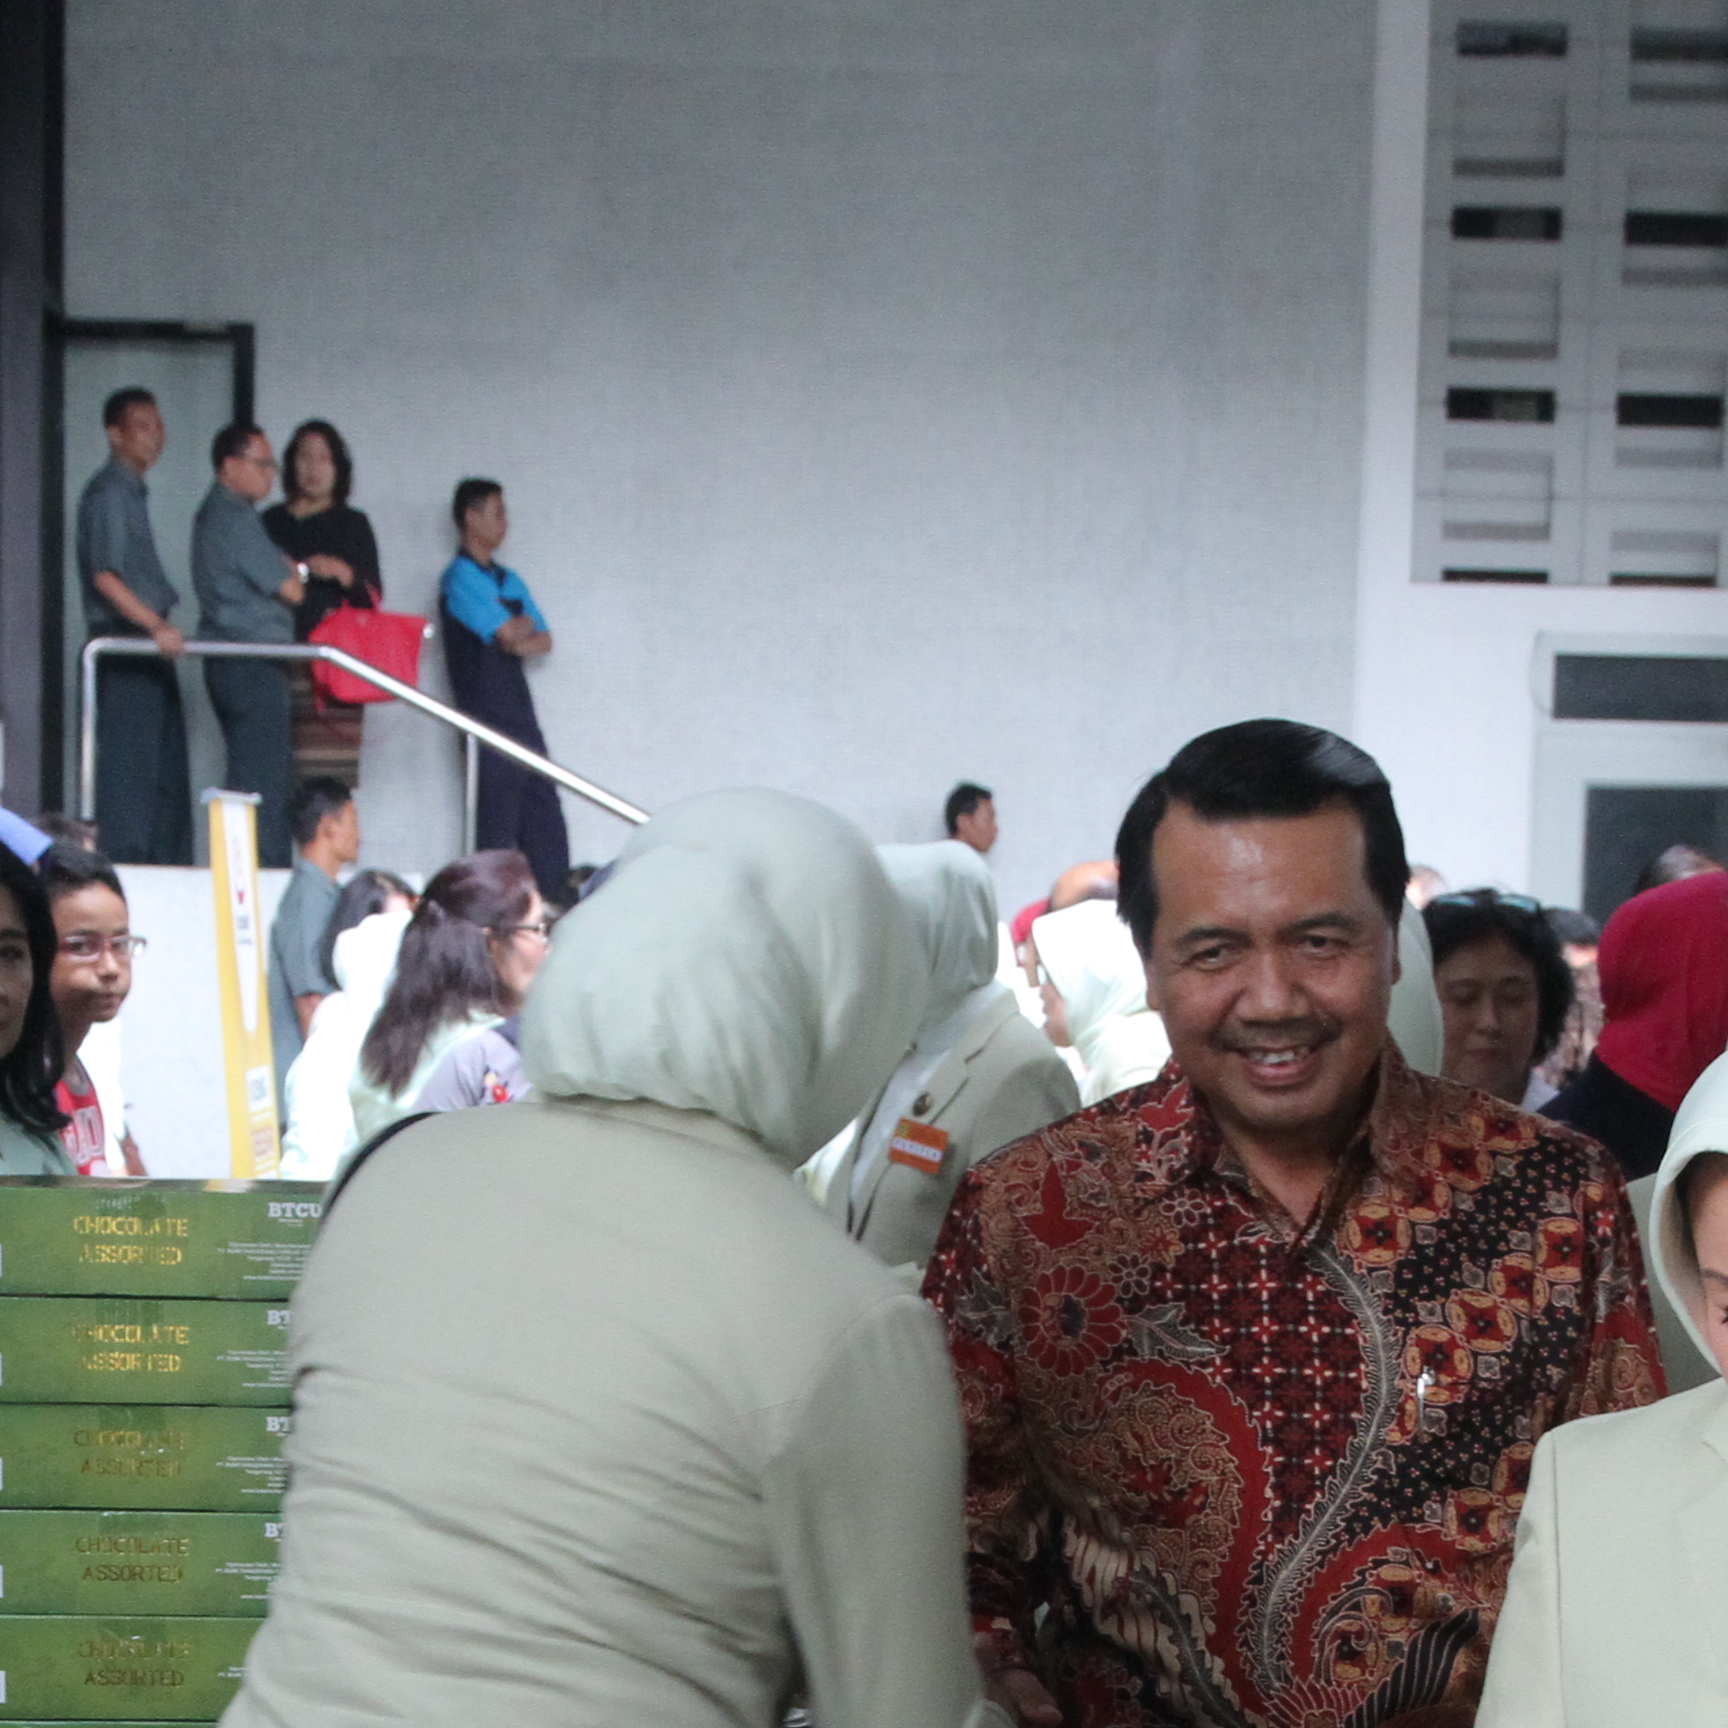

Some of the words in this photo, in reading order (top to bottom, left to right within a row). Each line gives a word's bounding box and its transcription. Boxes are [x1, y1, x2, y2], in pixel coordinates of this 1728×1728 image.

[73, 1215, 189, 1237] CHOCOLATE
[79, 1244, 183, 1265] ASSORTED
[72, 1324, 190, 1344] CHOCOLATE
[75, 1537, 190, 1556] CHOCOLATE
[83, 1565, 184, 1583] ASSORTED
[84, 1668, 185, 1687] ASSORTED
